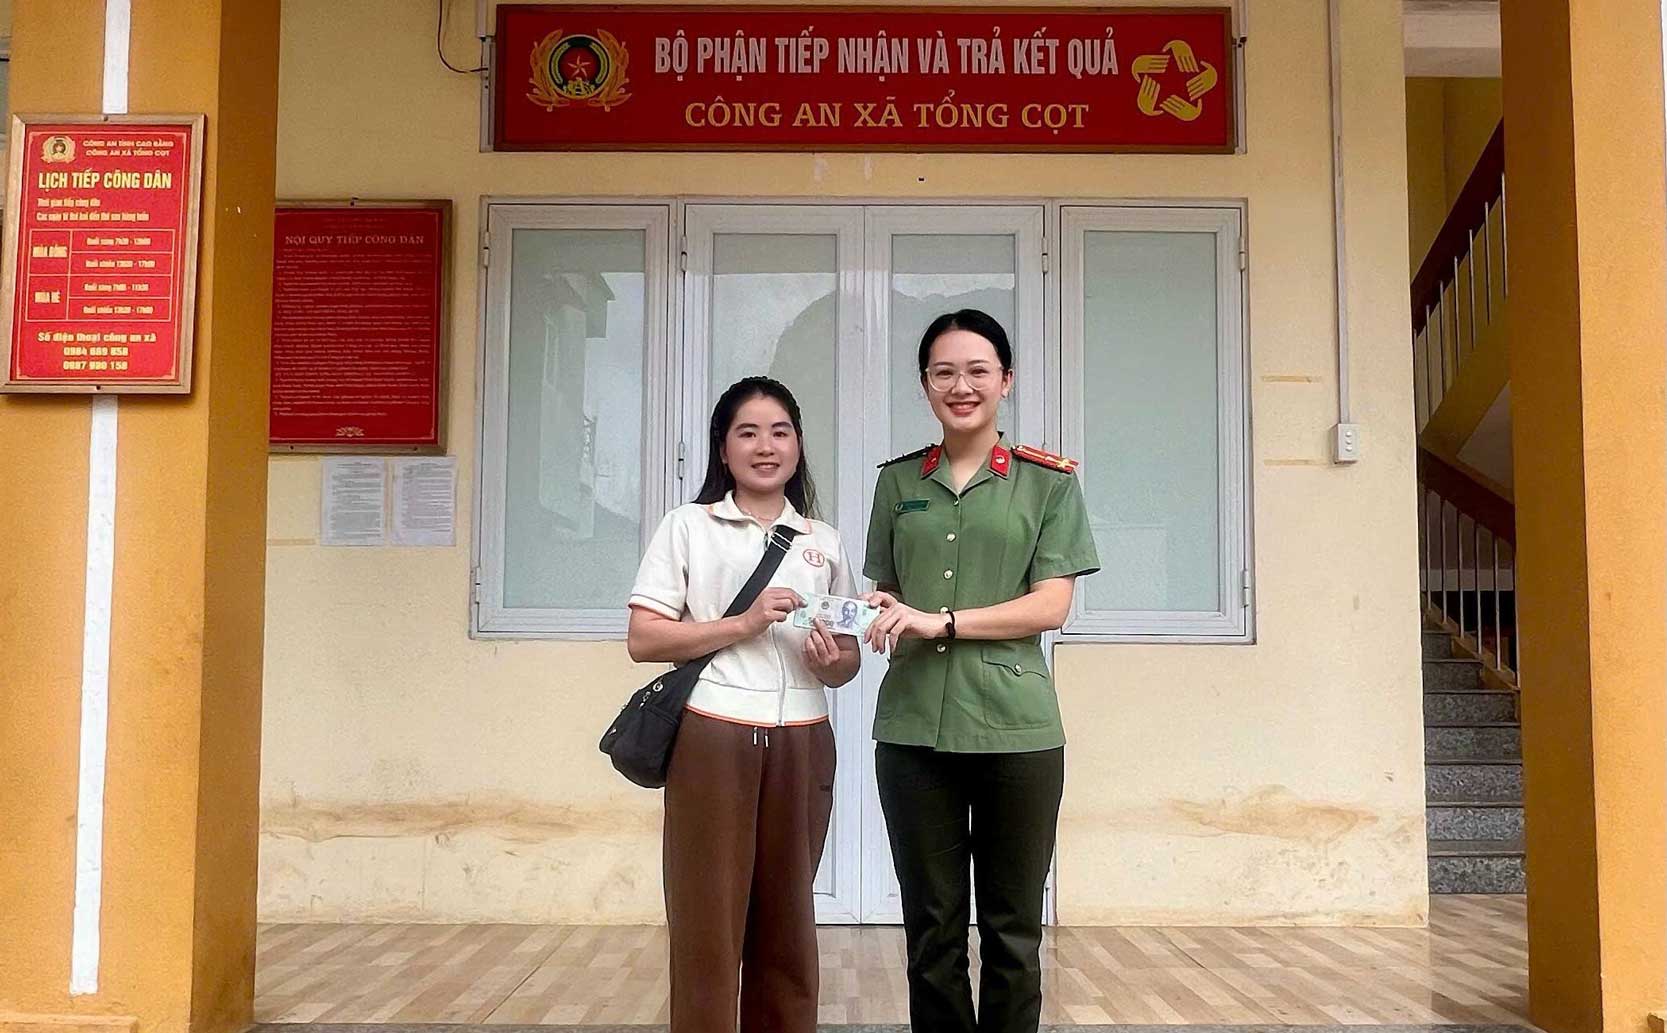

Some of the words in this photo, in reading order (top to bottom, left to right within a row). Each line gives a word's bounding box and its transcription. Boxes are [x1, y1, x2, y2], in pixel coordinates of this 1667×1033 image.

[655, 29, 689, 82] BỘ
[697, 29, 767, 82] PHẬN
[775, 25, 830, 74] TIẾP
[838, 29, 909, 82] NHẬN
[916, 30, 950, 75] VÀ
[957, 26, 1006, 75] TRẢ
[1013, 26, 1060, 75] KẾT
[1067, 26, 1119, 80] QUẢ
[685, 95, 783, 128] CÔNG
[792, 102, 843, 128] AN
[853, 96, 903, 128] XÃ
[913, 89, 1010, 128] TỔNG
[1021, 103, 1090, 135] CỌT
[83, 139, 105, 147] CÔNG
[38, 172, 68, 192] LỊCH
[71, 168, 100, 189] TIẾP
[103, 170, 141, 189] CÔNG
[144, 170, 172, 189] DÂN
[37, 332, 51, 342] Số
